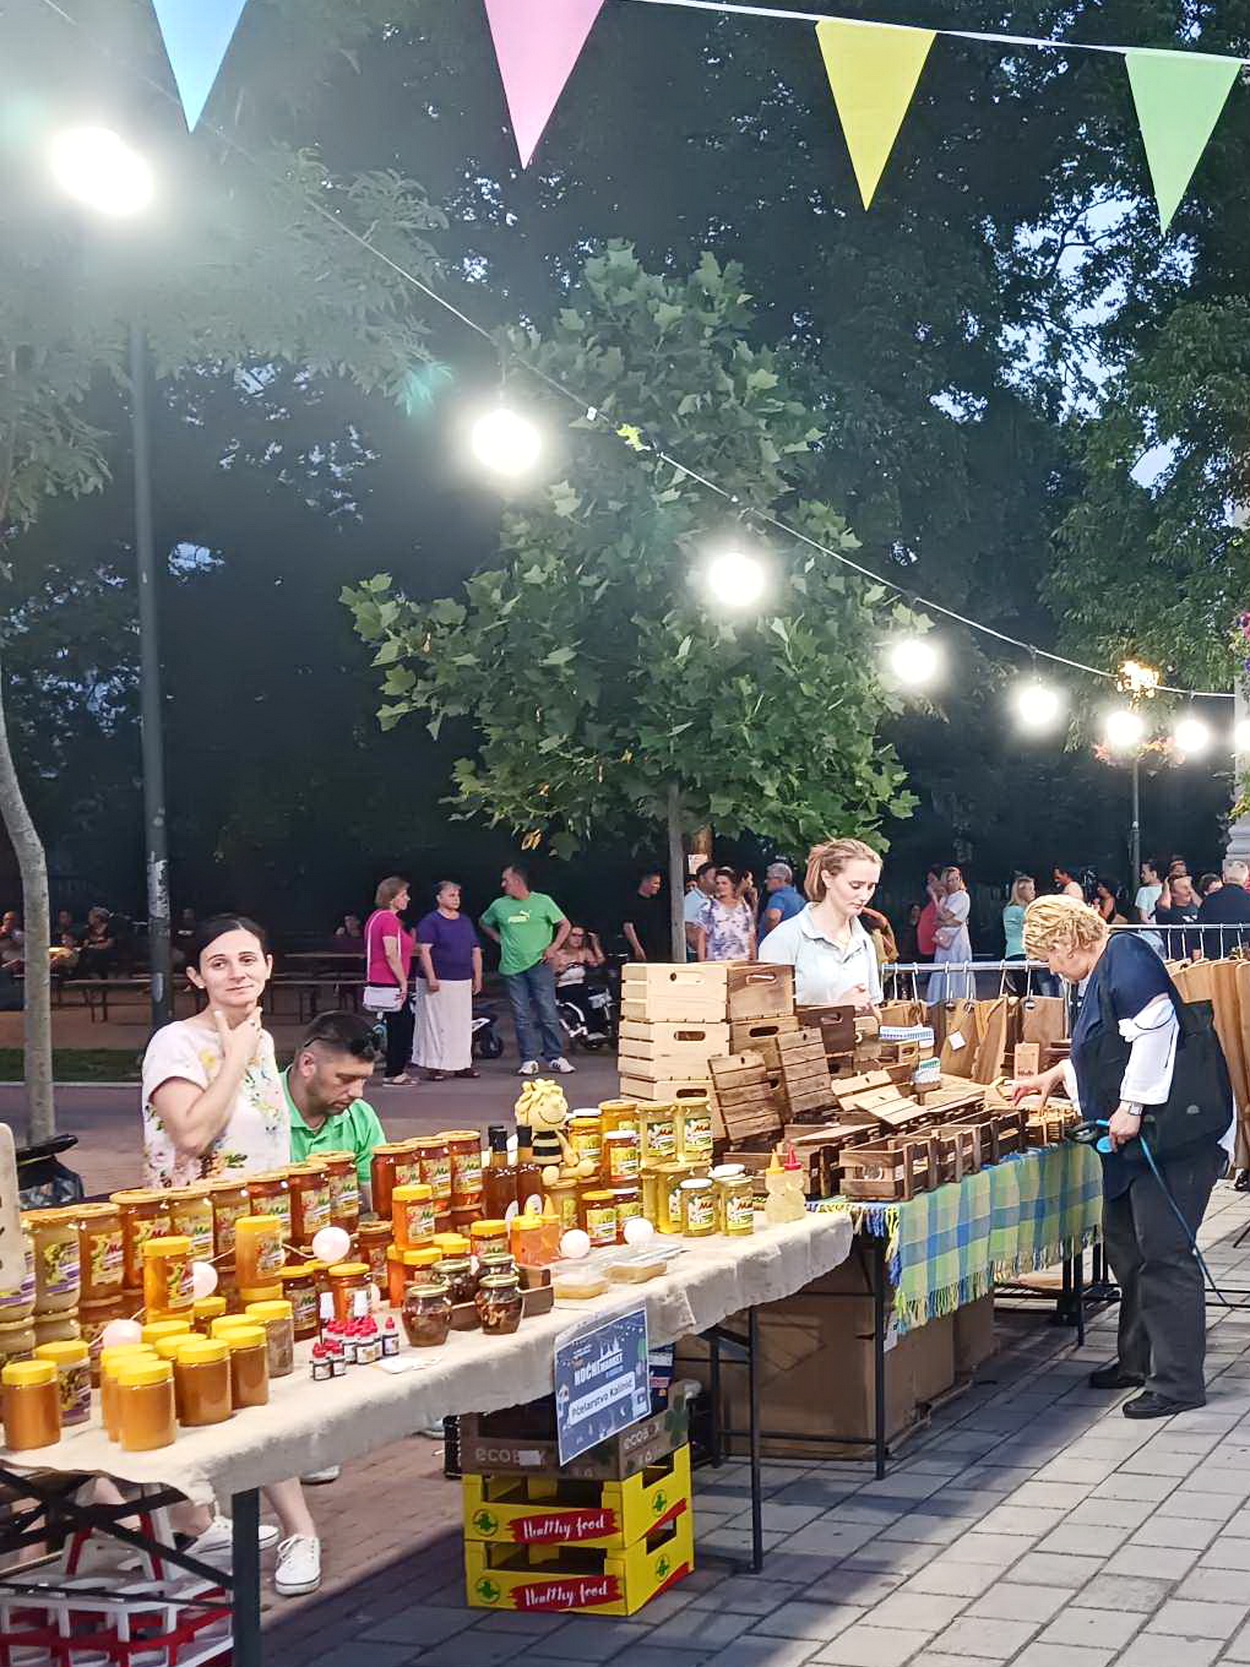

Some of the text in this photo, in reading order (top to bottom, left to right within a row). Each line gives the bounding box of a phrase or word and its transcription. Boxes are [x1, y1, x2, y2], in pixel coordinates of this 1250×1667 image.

[523, 1514, 605, 1541] Healthy food
[525, 1580, 608, 1607] Healthy food
